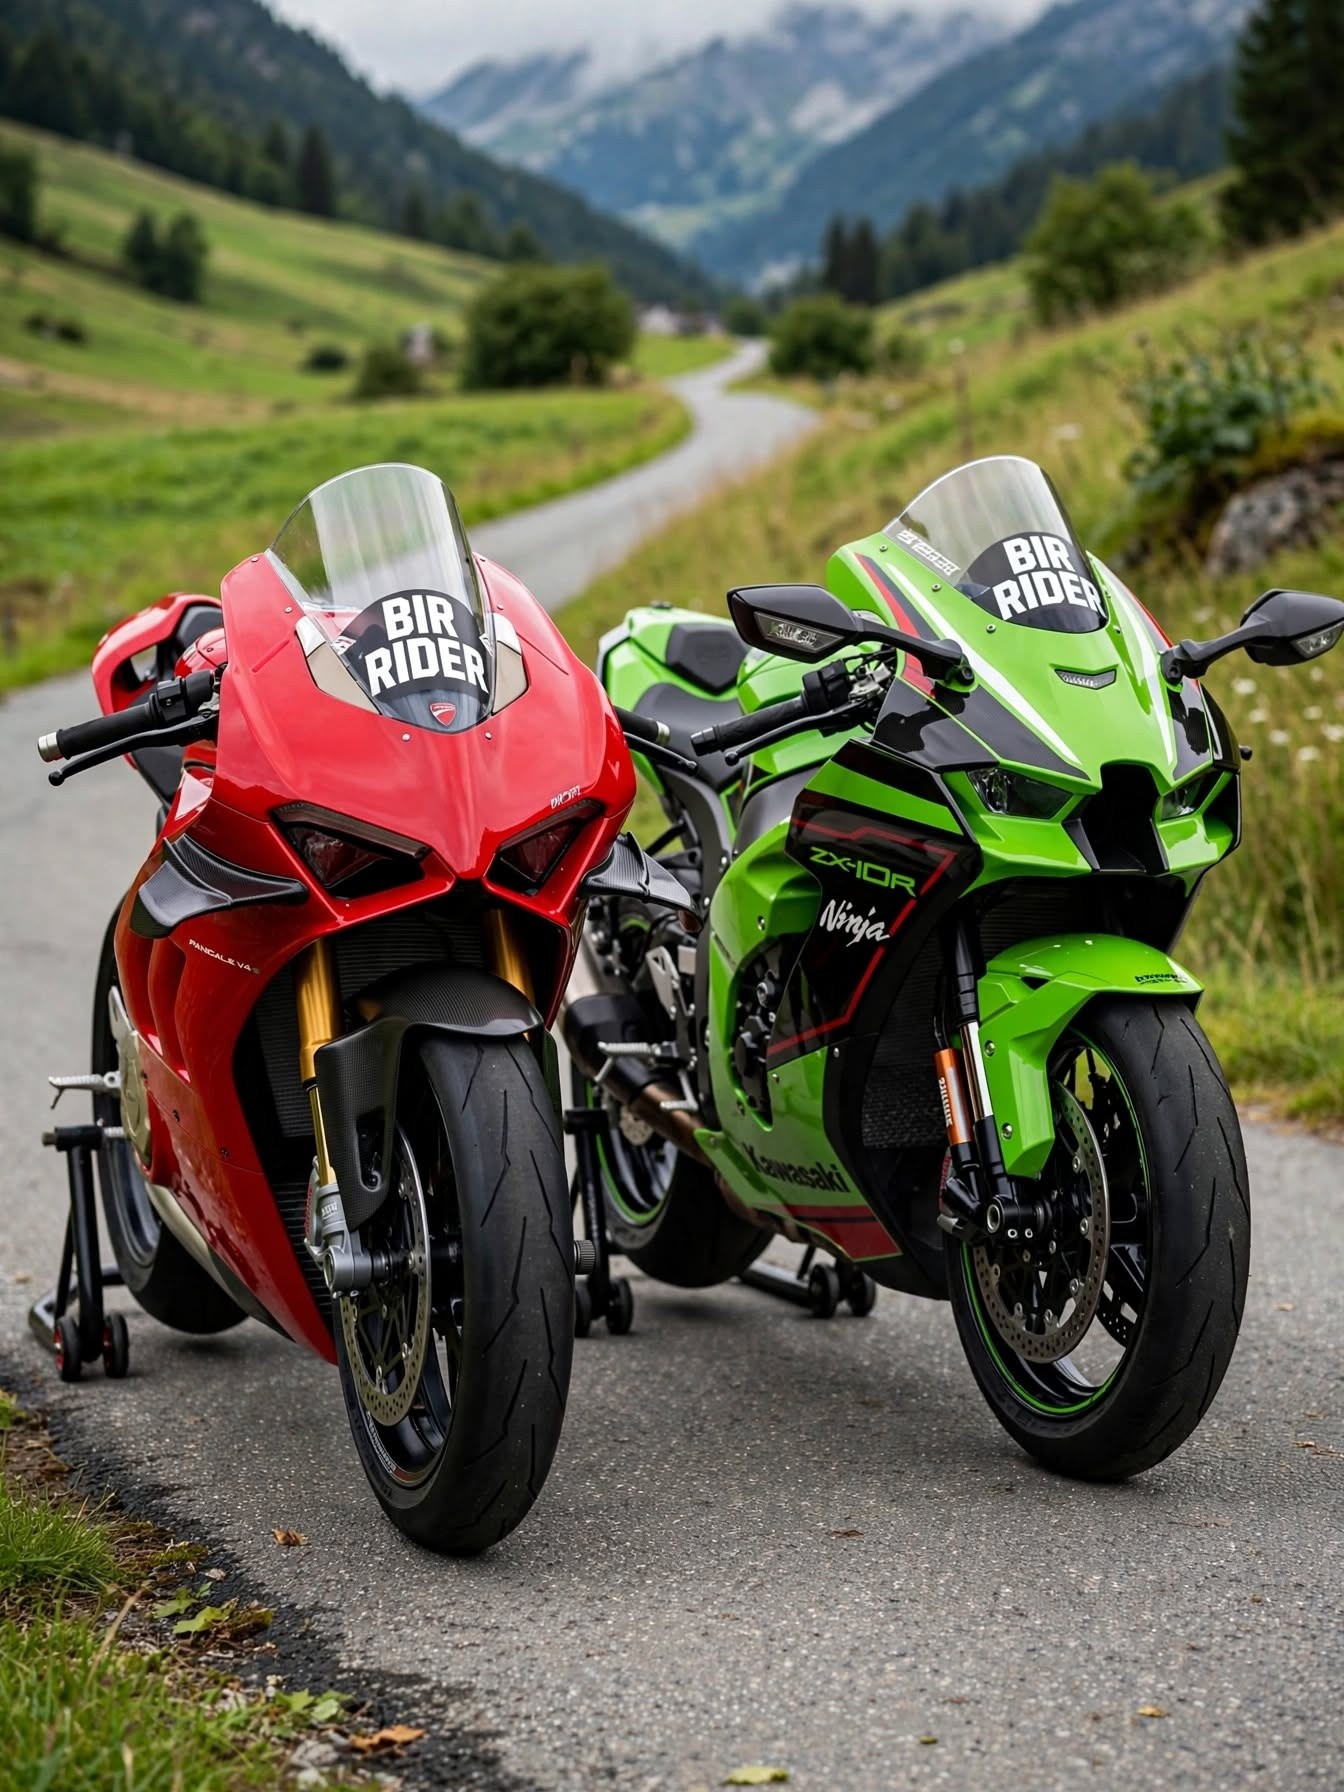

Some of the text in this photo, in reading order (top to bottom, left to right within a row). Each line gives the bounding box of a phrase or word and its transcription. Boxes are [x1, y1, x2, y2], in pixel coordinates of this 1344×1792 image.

[1003, 535, 1076, 575] BIR
[382, 594, 458, 641] BIR
[992, 570, 1108, 620] RIDER
[364, 637, 489, 697] RIDER
[809, 846, 916, 897] ZX-10R
[819, 899, 890, 947] Ninja
[742, 1142, 850, 1192] Kawasaki
